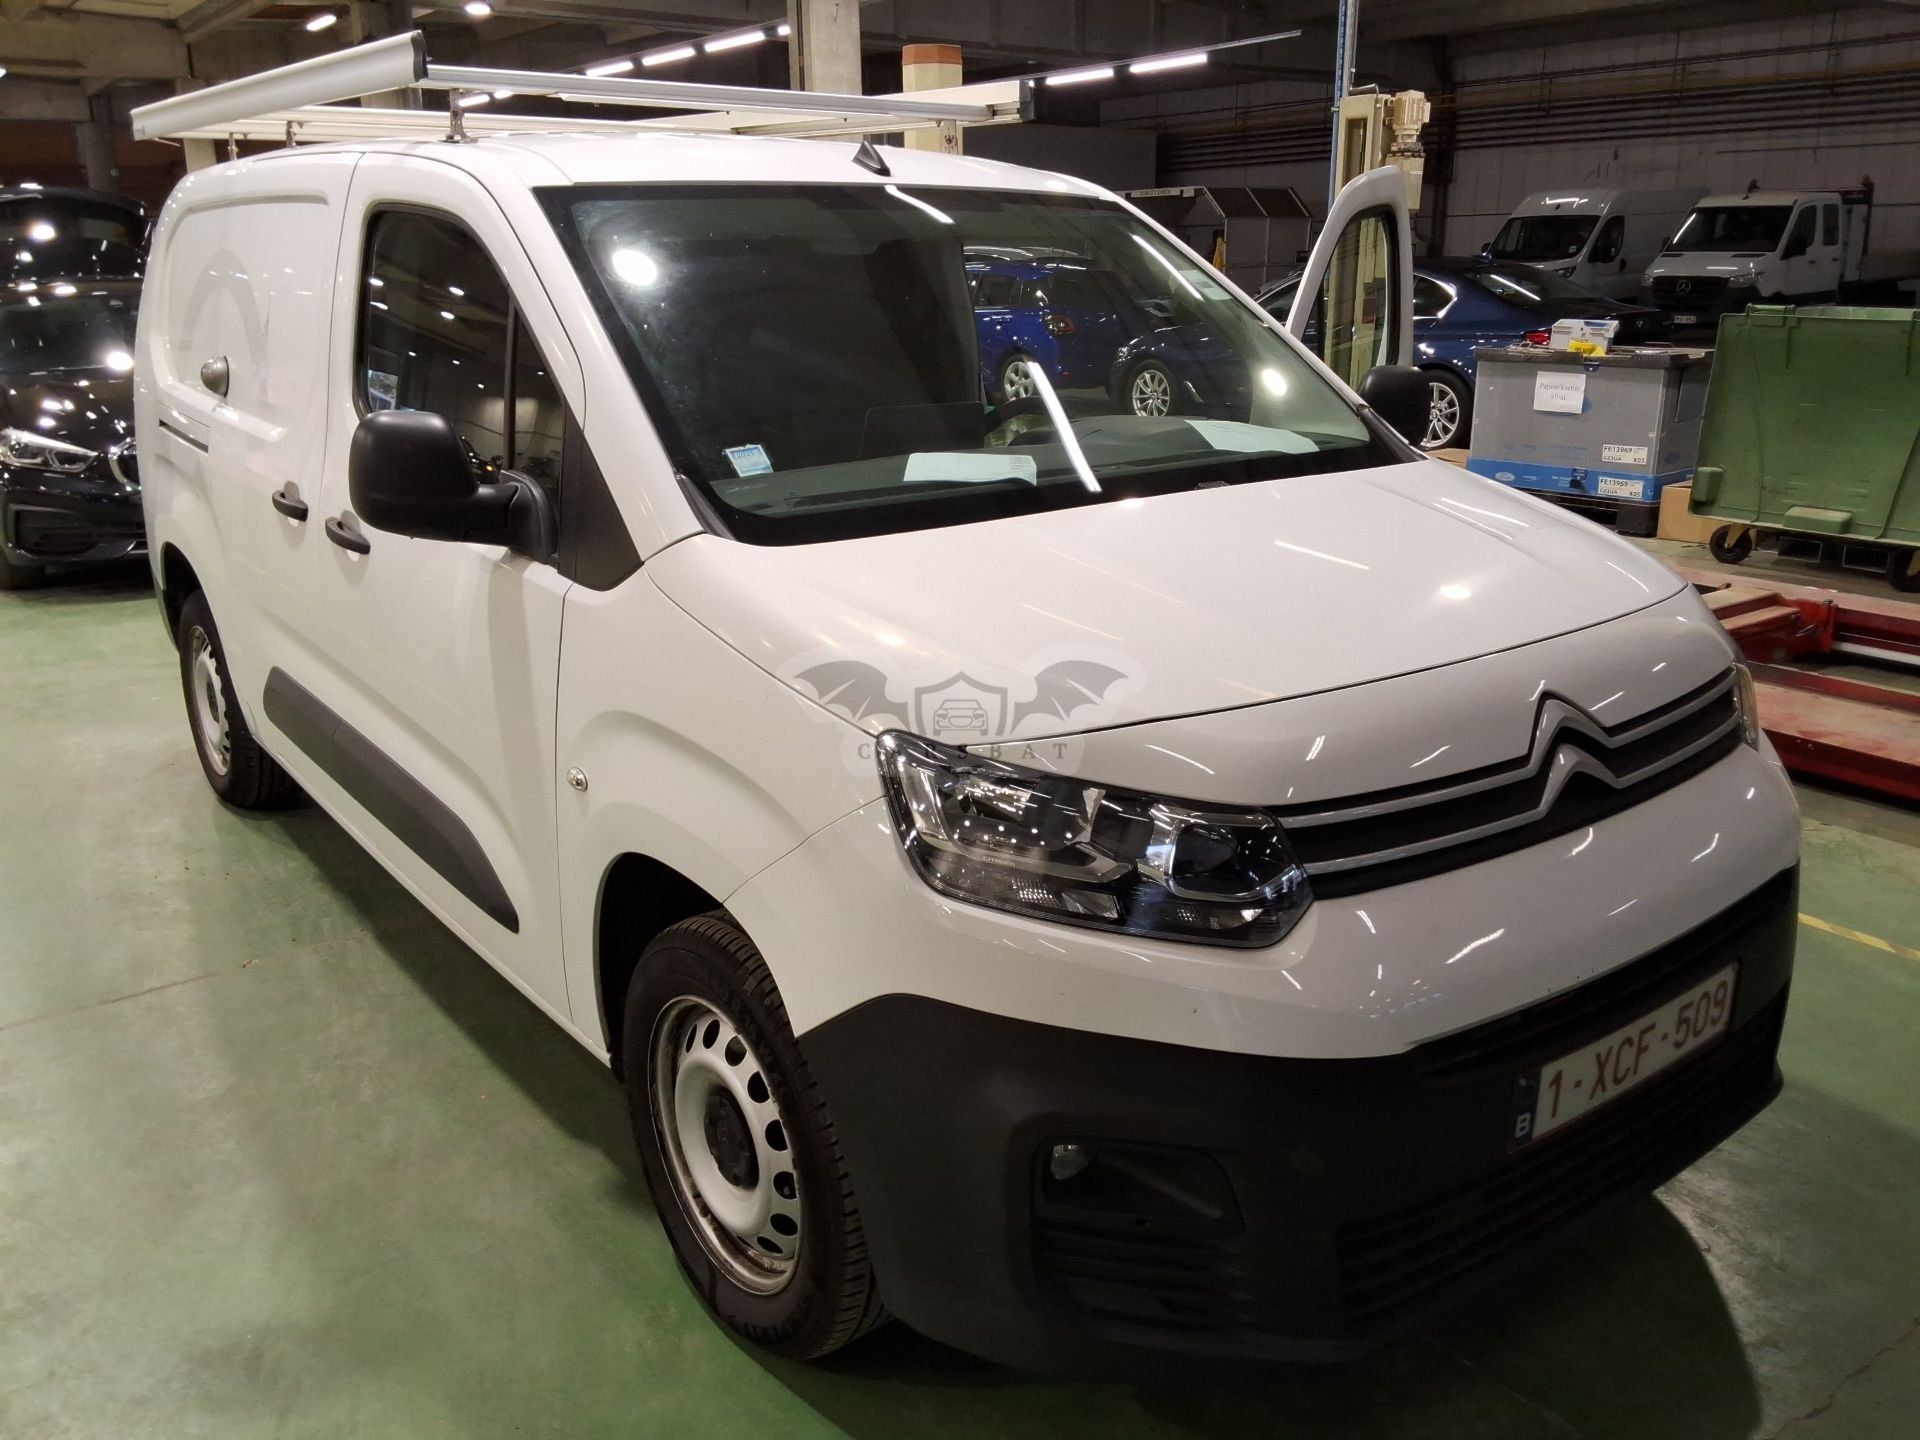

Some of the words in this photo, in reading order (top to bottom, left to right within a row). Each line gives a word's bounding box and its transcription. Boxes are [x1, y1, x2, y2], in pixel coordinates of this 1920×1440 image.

[1603, 445, 1633, 453] FE13969
[1600, 478, 1629, 487] FE13969
[1547, 978, 1729, 1120] 1-XCF-509
[1514, 1111, 1532, 1139] B
